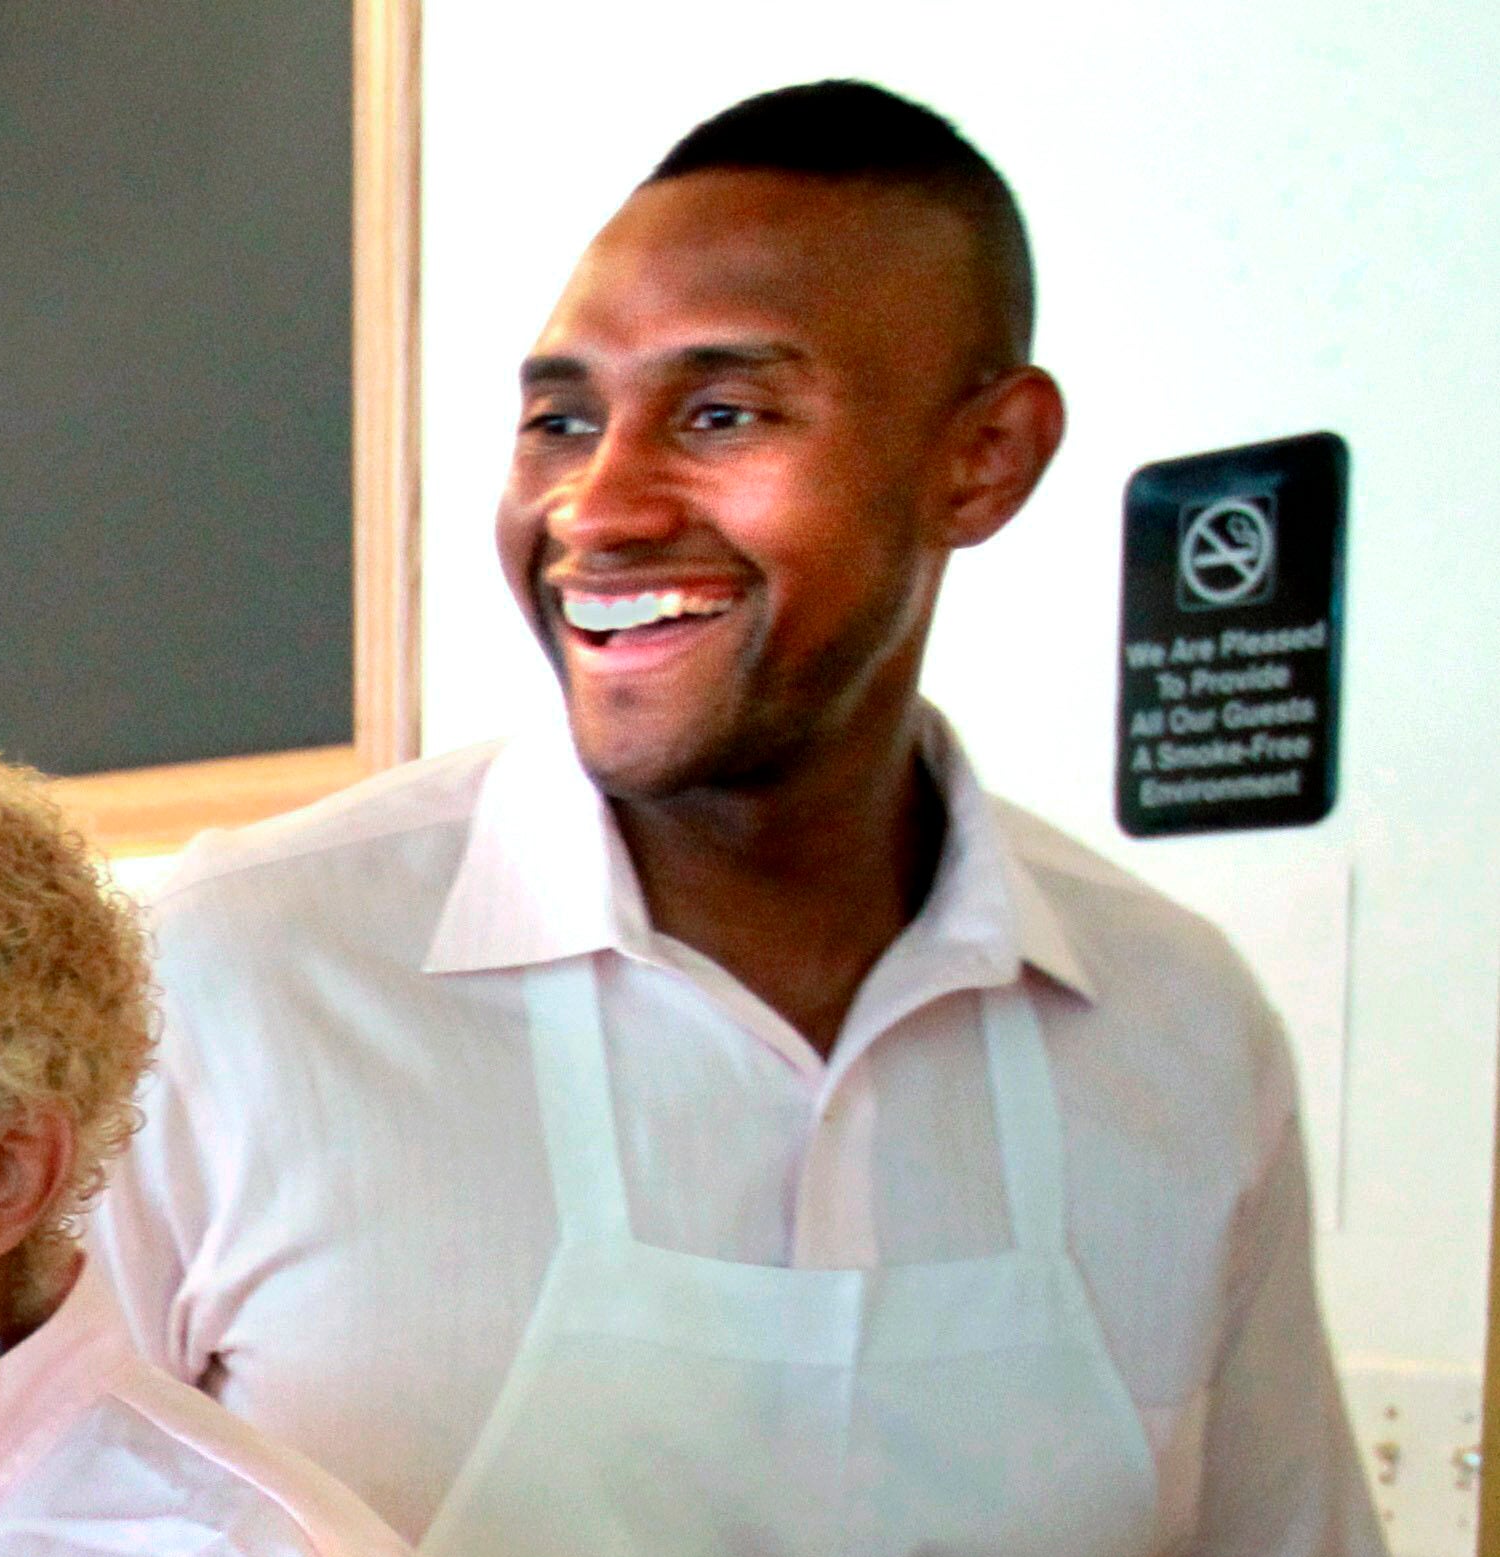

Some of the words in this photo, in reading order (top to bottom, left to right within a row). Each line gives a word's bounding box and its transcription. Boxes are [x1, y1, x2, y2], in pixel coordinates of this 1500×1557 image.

[1127, 641, 1166, 669] We
[1170, 637, 1214, 663] Are
[1220, 618, 1327, 657] Pleased
[1156, 672, 1187, 699] To
[1191, 661, 1290, 693] Provide
[1130, 707, 1164, 736] All
[1168, 706, 1216, 734] Our
[1221, 697, 1315, 729] Guests
[1132, 744, 1151, 772] A
[1156, 733, 1311, 769] Smoke-Free
[1139, 768, 1301, 808] Environment
